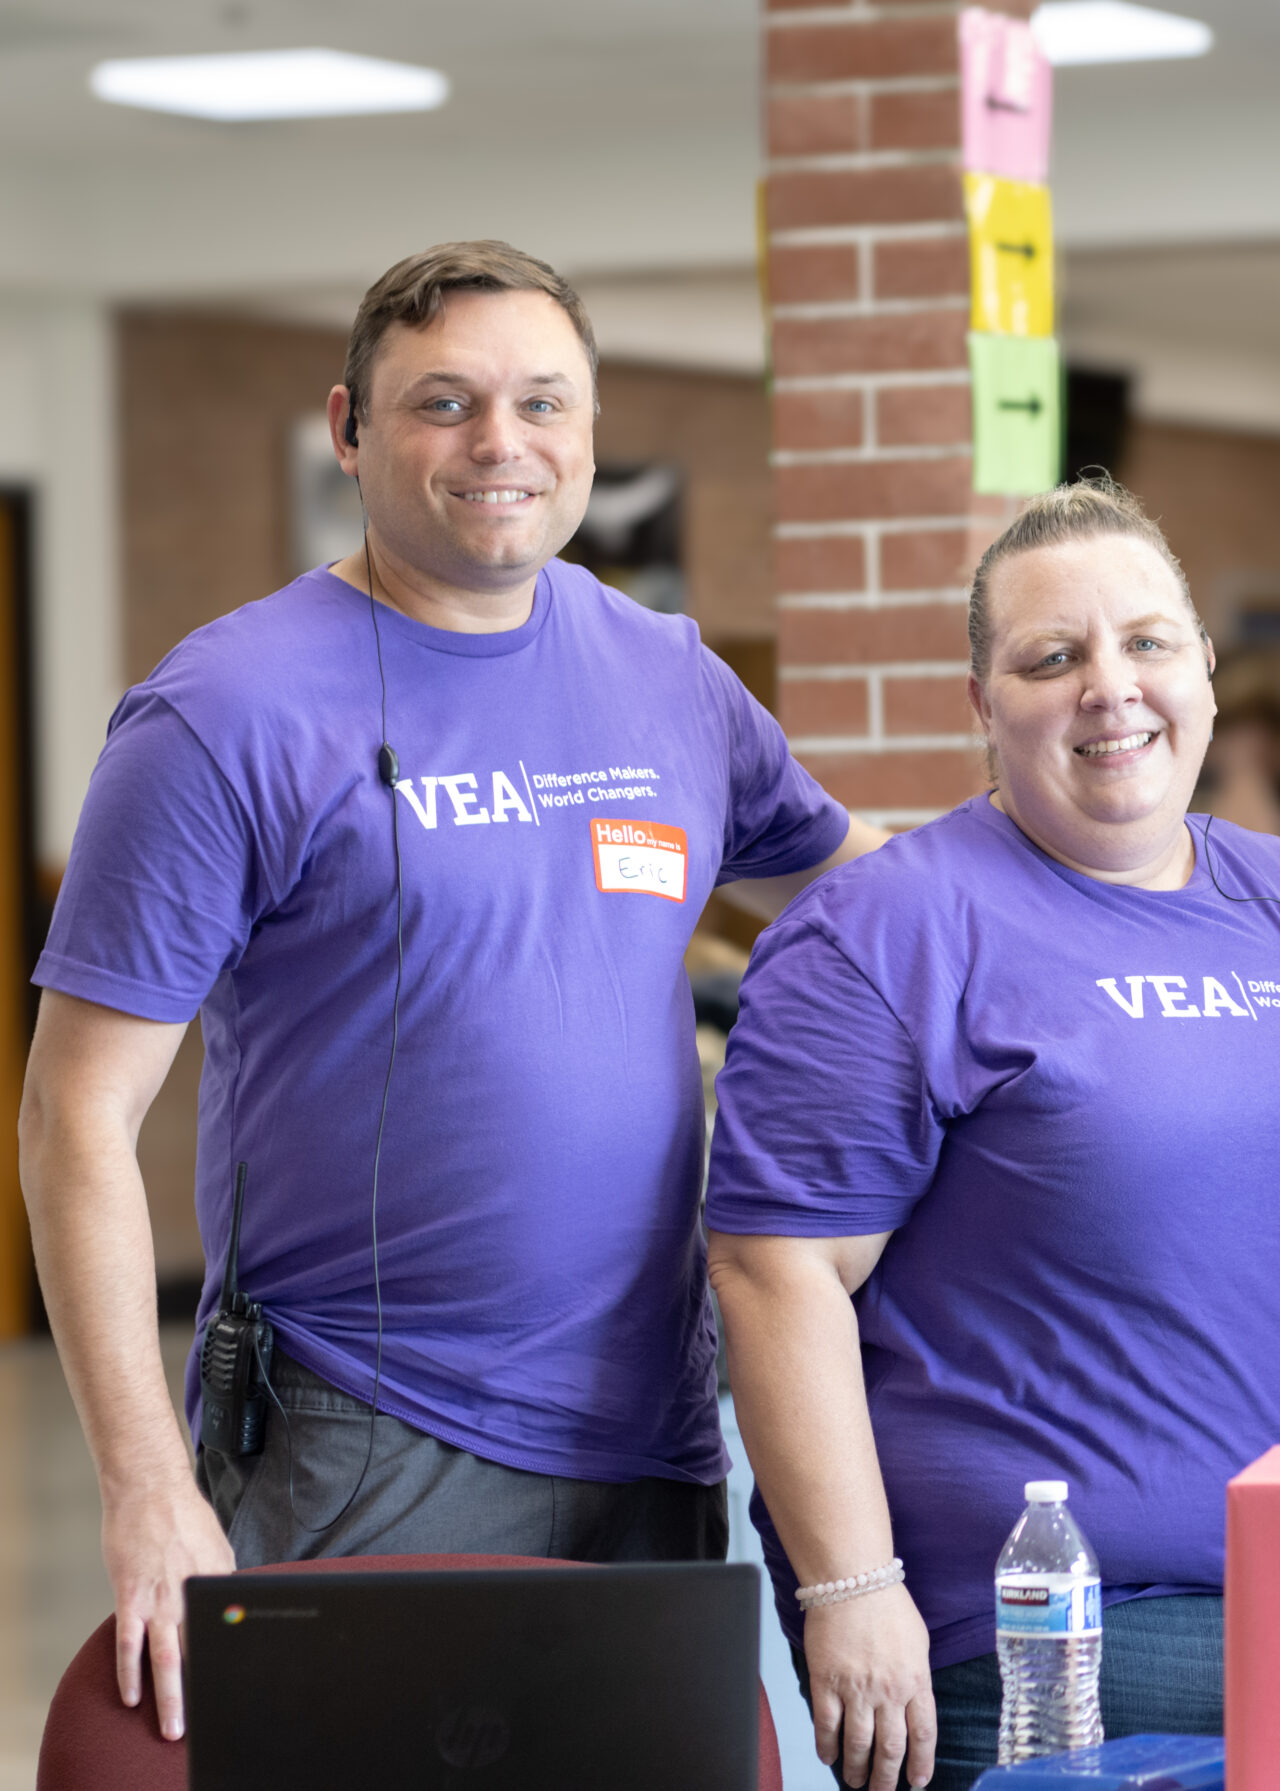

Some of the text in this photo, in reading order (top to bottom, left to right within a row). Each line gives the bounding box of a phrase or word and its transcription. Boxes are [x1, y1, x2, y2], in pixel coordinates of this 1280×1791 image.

[533, 765, 660, 789] Difference Makers.
[395, 771, 533, 830] VEA
[538, 785, 658, 809] World Changers.
[596, 823, 646, 844] Hello
[618, 856, 668, 884] Eric
[1096, 976, 1250, 1019] VEA
[1002, 1588, 1048, 1602] KIRKLAND
